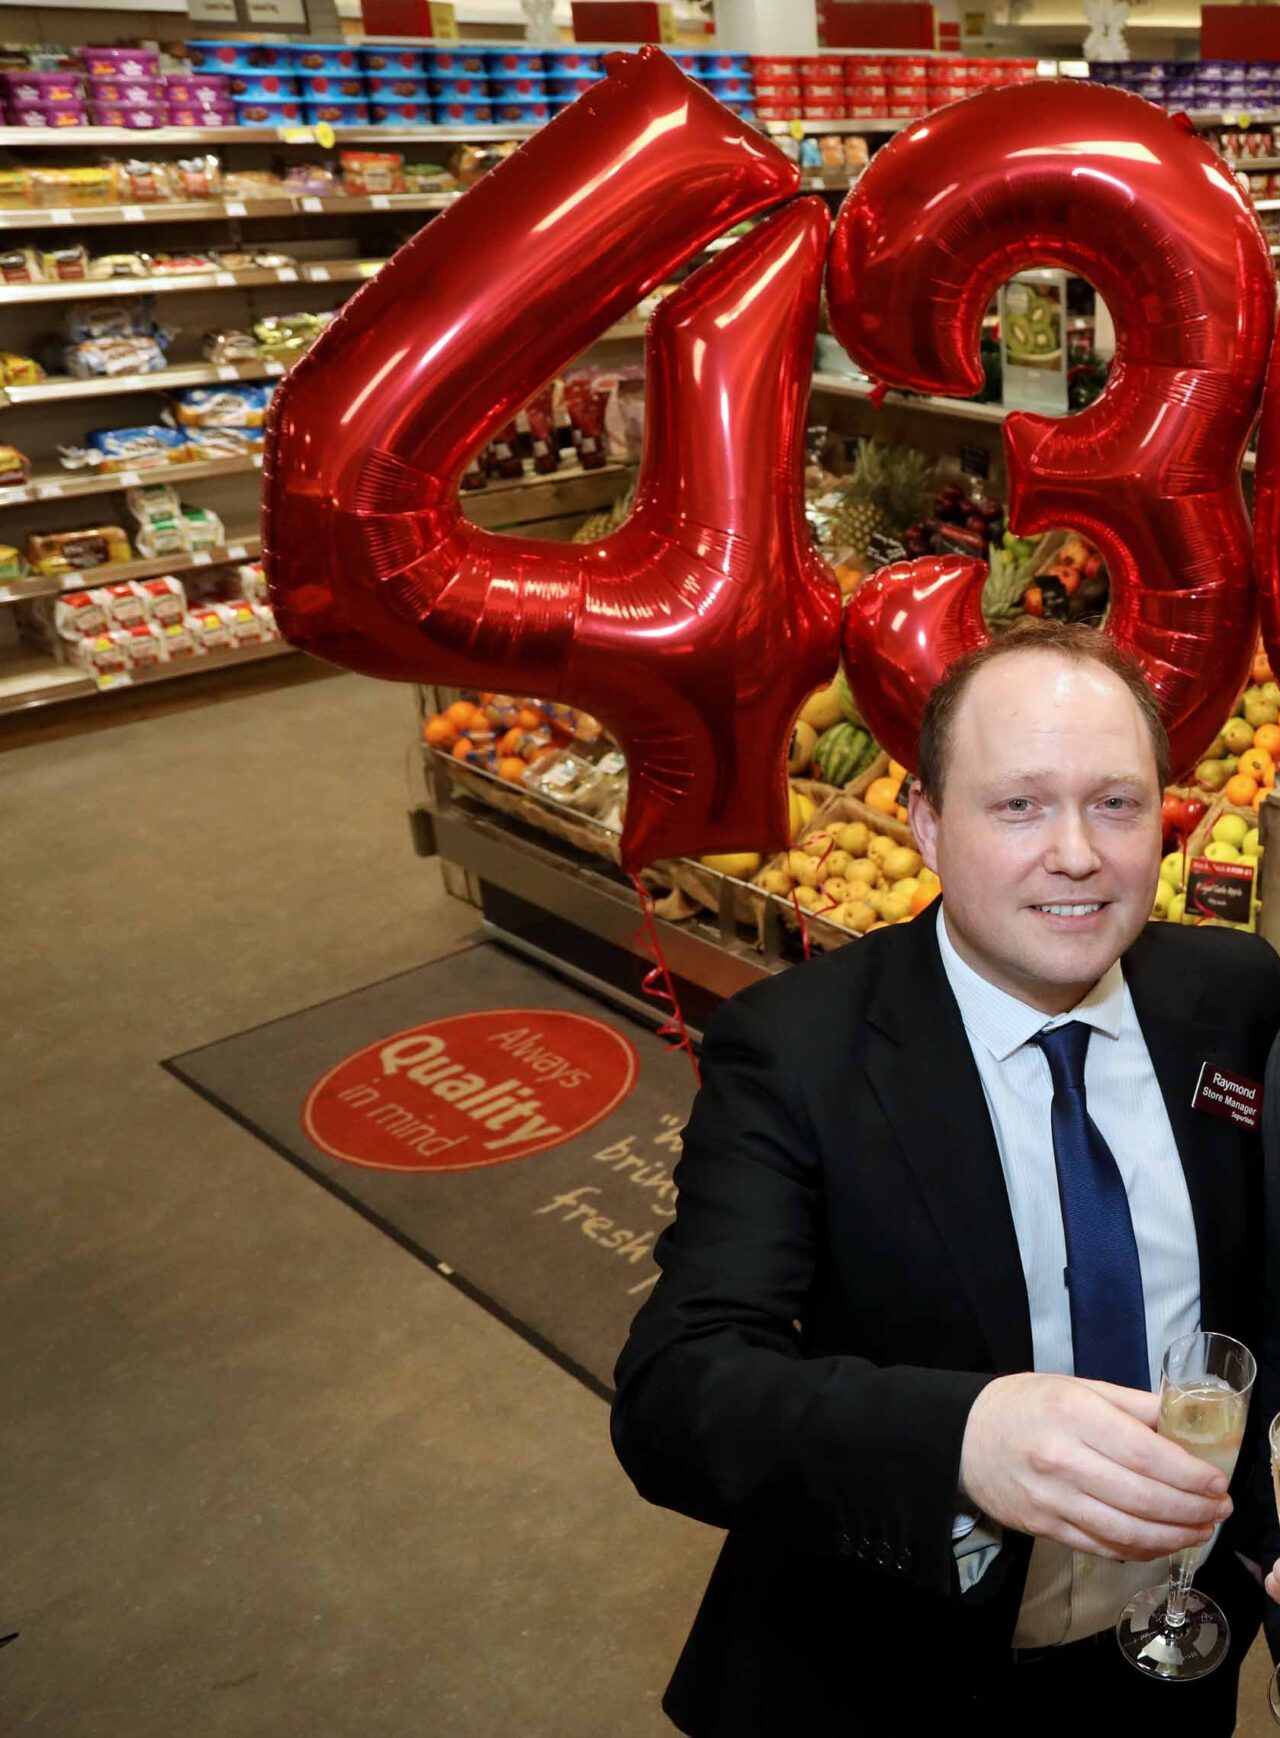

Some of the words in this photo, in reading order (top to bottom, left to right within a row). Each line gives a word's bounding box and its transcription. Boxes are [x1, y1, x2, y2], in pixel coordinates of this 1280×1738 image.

[378, 1034, 564, 1151] Quality
[488, 1026, 593, 1090] Always
[1212, 1072, 1256, 1100] Raymond
[337, 1077, 381, 1108] in
[367, 1101, 469, 1157] mind
[1202, 1086, 1224, 1103] Store
[1224, 1095, 1257, 1116] Manager
[533, 1187, 656, 1264] fresh
